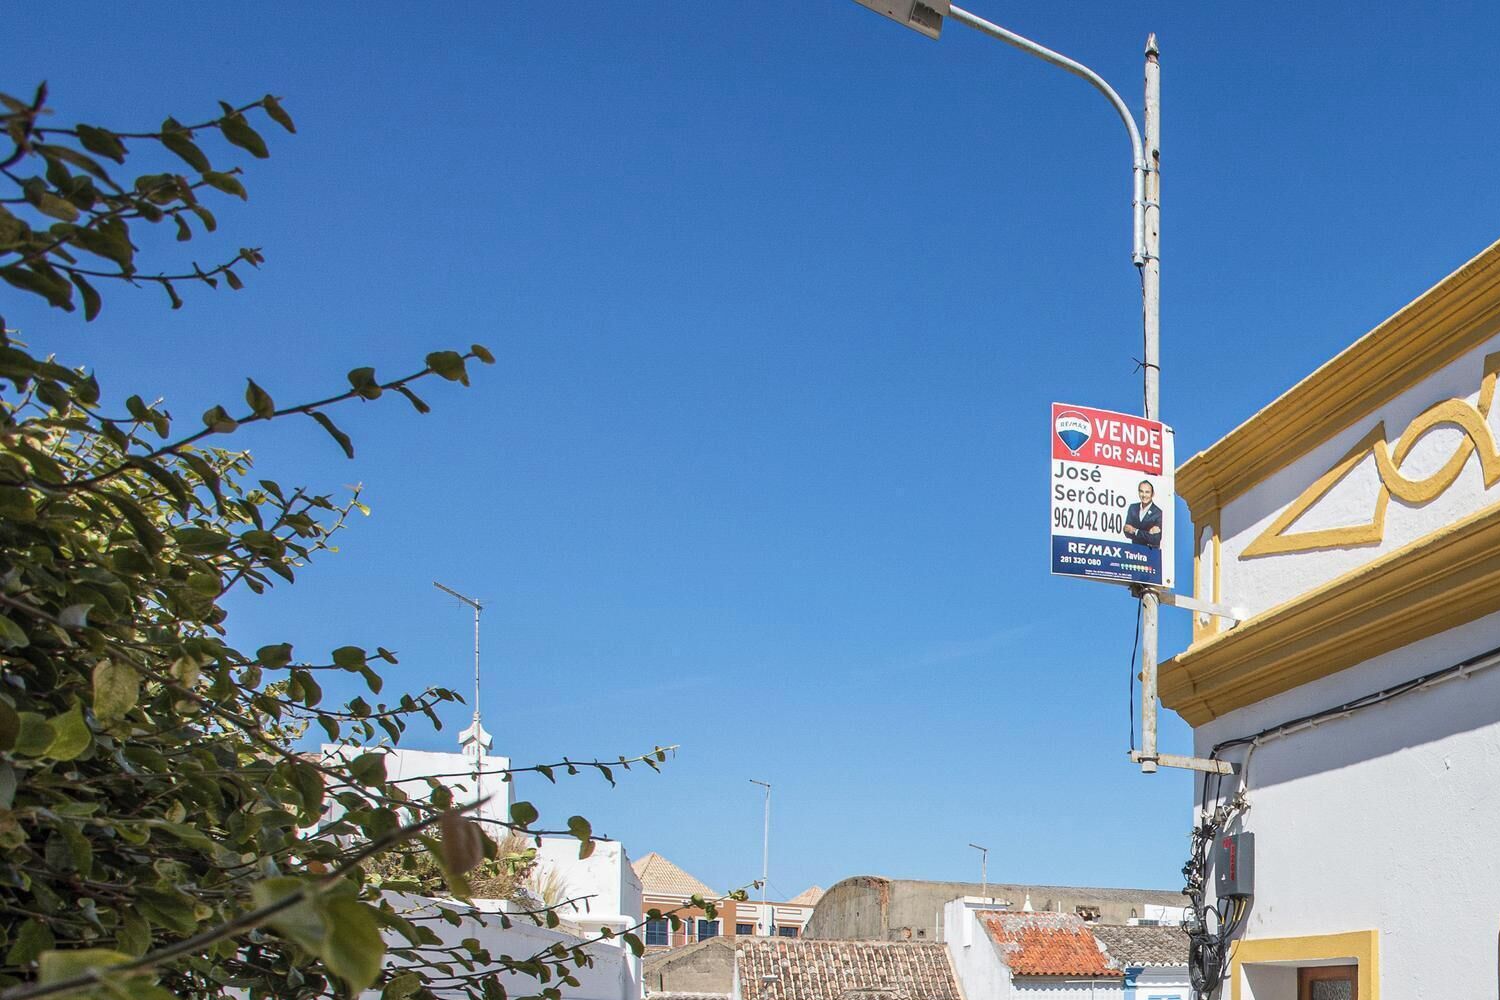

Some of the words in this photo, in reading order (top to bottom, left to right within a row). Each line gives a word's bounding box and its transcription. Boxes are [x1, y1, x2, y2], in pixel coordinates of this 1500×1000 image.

[1060, 421, 1088, 430] RE/MAX
[1095, 418, 1160, 449] VENDE
[1094, 442, 1121, 461] FOR
[1126, 448, 1160, 468] SALE
[1054, 462, 1102, 483] José
[1054, 485, 1127, 508] Serôdio
[1054, 507, 1074, 529] 962
[1077, 509, 1098, 532] 042
[1101, 511, 1122, 534] 040
[1060, 556, 1072, 564] 281
[1068, 542, 1122, 558] RE/MAX
[1124, 551, 1147, 562] Tavira
